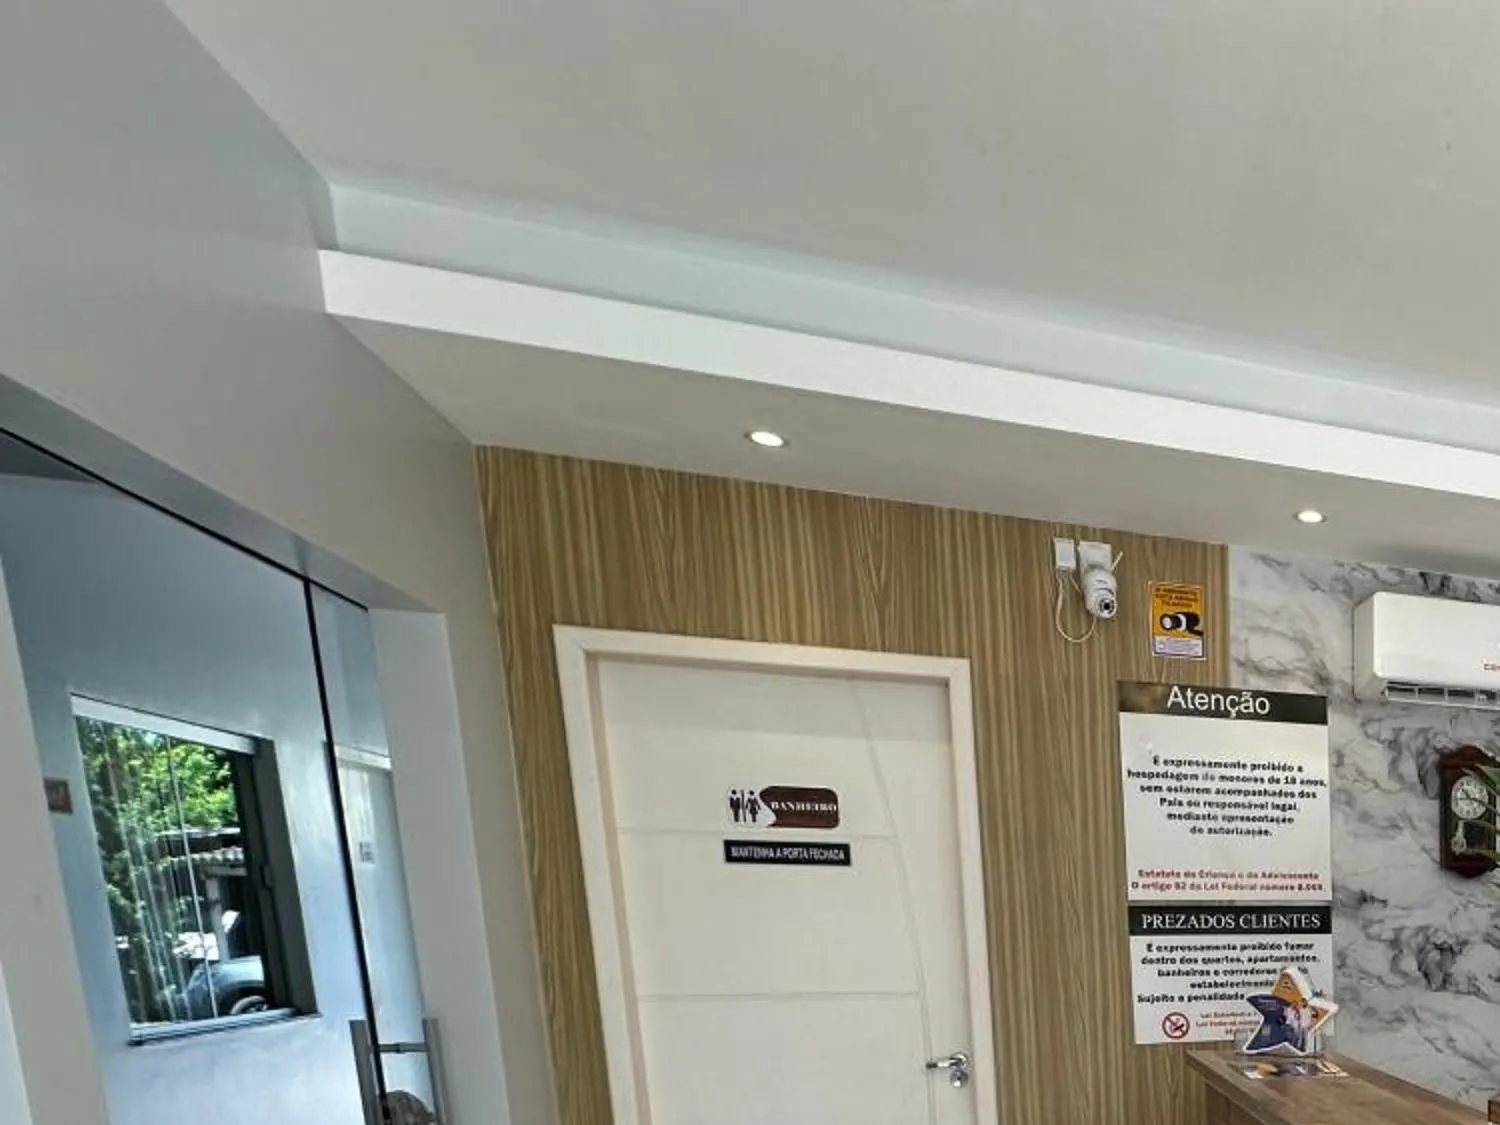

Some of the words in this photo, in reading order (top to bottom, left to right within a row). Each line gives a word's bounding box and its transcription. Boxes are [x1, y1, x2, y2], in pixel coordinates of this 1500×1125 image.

[1167, 685, 1270, 718] Atenção
[1162, 758, 1248, 770] expressamente
[1250, 761, 1295, 773] proibido
[1127, 768, 1200, 782] hospedagem
[1218, 774, 1265, 784] menores
[1267, 775, 1281, 785] de
[1140, 785, 1163, 793] sem
[1166, 785, 1212, 795] estarem
[1214, 787, 1296, 799] acompanhados
[1298, 789, 1318, 799] dos
[770, 800, 837, 812] BANHEIRO
[1159, 797, 1184, 807] Pais
[1186, 799, 1201, 808] ou
[1203, 800, 1269, 811] responsável
[1166, 811, 1219, 821] mediante
[1221, 814, 1295, 825] apresentação
[1188, 825, 1204, 835] de
[731, 846, 775, 858] MANTENHA
[782, 847, 809, 860] PORTA
[809, 848, 845, 860] FECHADA
[1138, 868, 1181, 878] Estatuto
[1131, 881, 1139, 890] O
[1141, 881, 1173, 892] artigo
[1204, 882, 1219, 891] Lei
[1141, 912, 1236, 929] PREZADOS
[1239, 913, 1321, 929] CLIENTES
[1155, 943, 1237, 954] expressamente
[1239, 941, 1282, 953] proibido
[1284, 941, 1315, 951] fumar
[1140, 956, 1177, 965] dentro
[1179, 956, 1199, 965] dos
[1157, 967, 1211, 977] banheiros
[1213, 969, 1221, 977] e
[1222, 967, 1278, 977] corredores
[1137, 992, 1175, 1004] Sujeito
